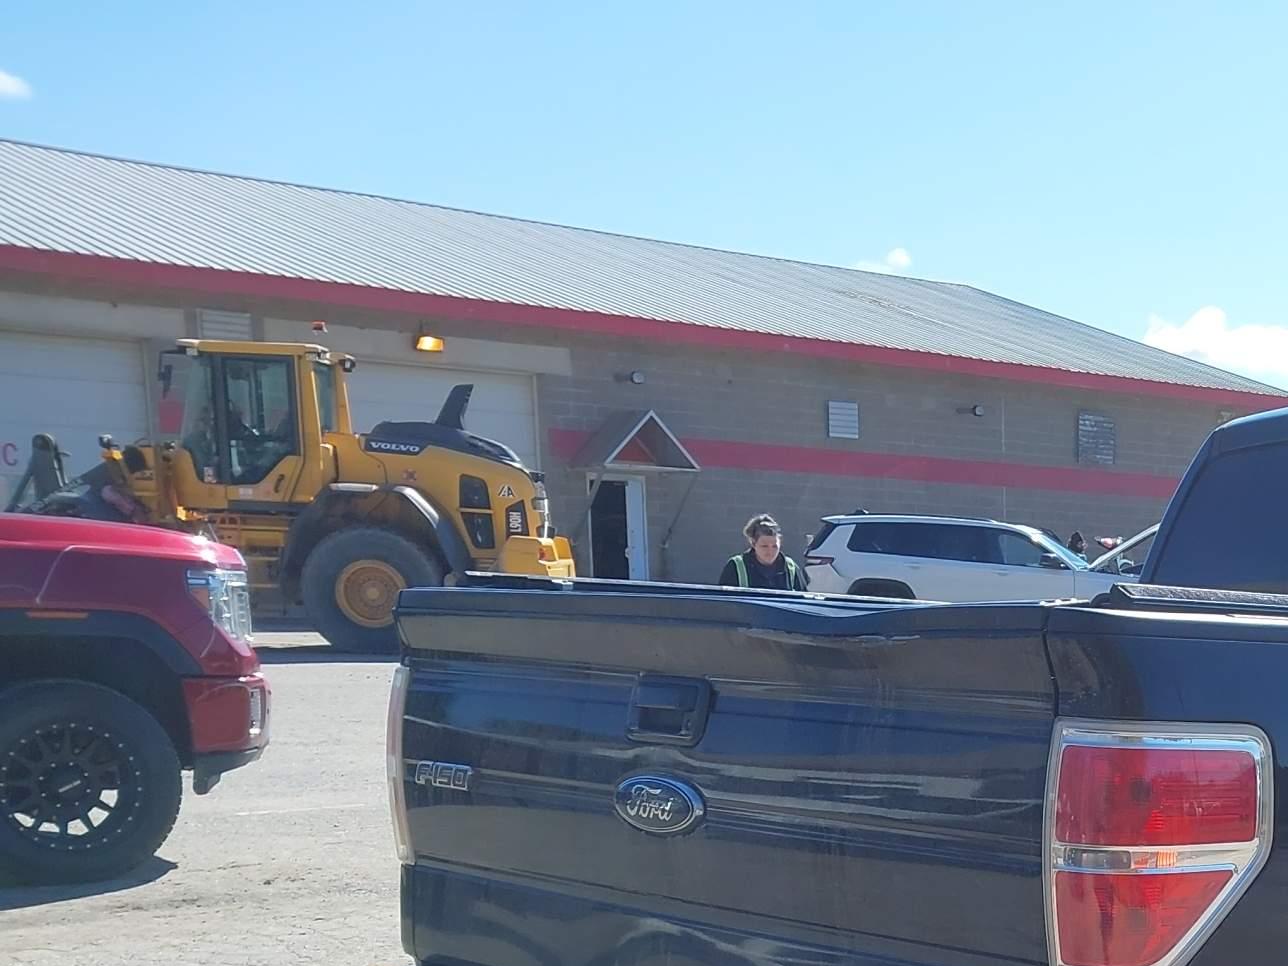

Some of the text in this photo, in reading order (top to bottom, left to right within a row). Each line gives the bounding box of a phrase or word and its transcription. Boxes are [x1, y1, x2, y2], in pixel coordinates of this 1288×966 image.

[369, 441, 420, 453] VOLVO
[509, 511, 522, 533] L90H
[626, 784, 676, 822] Ford
